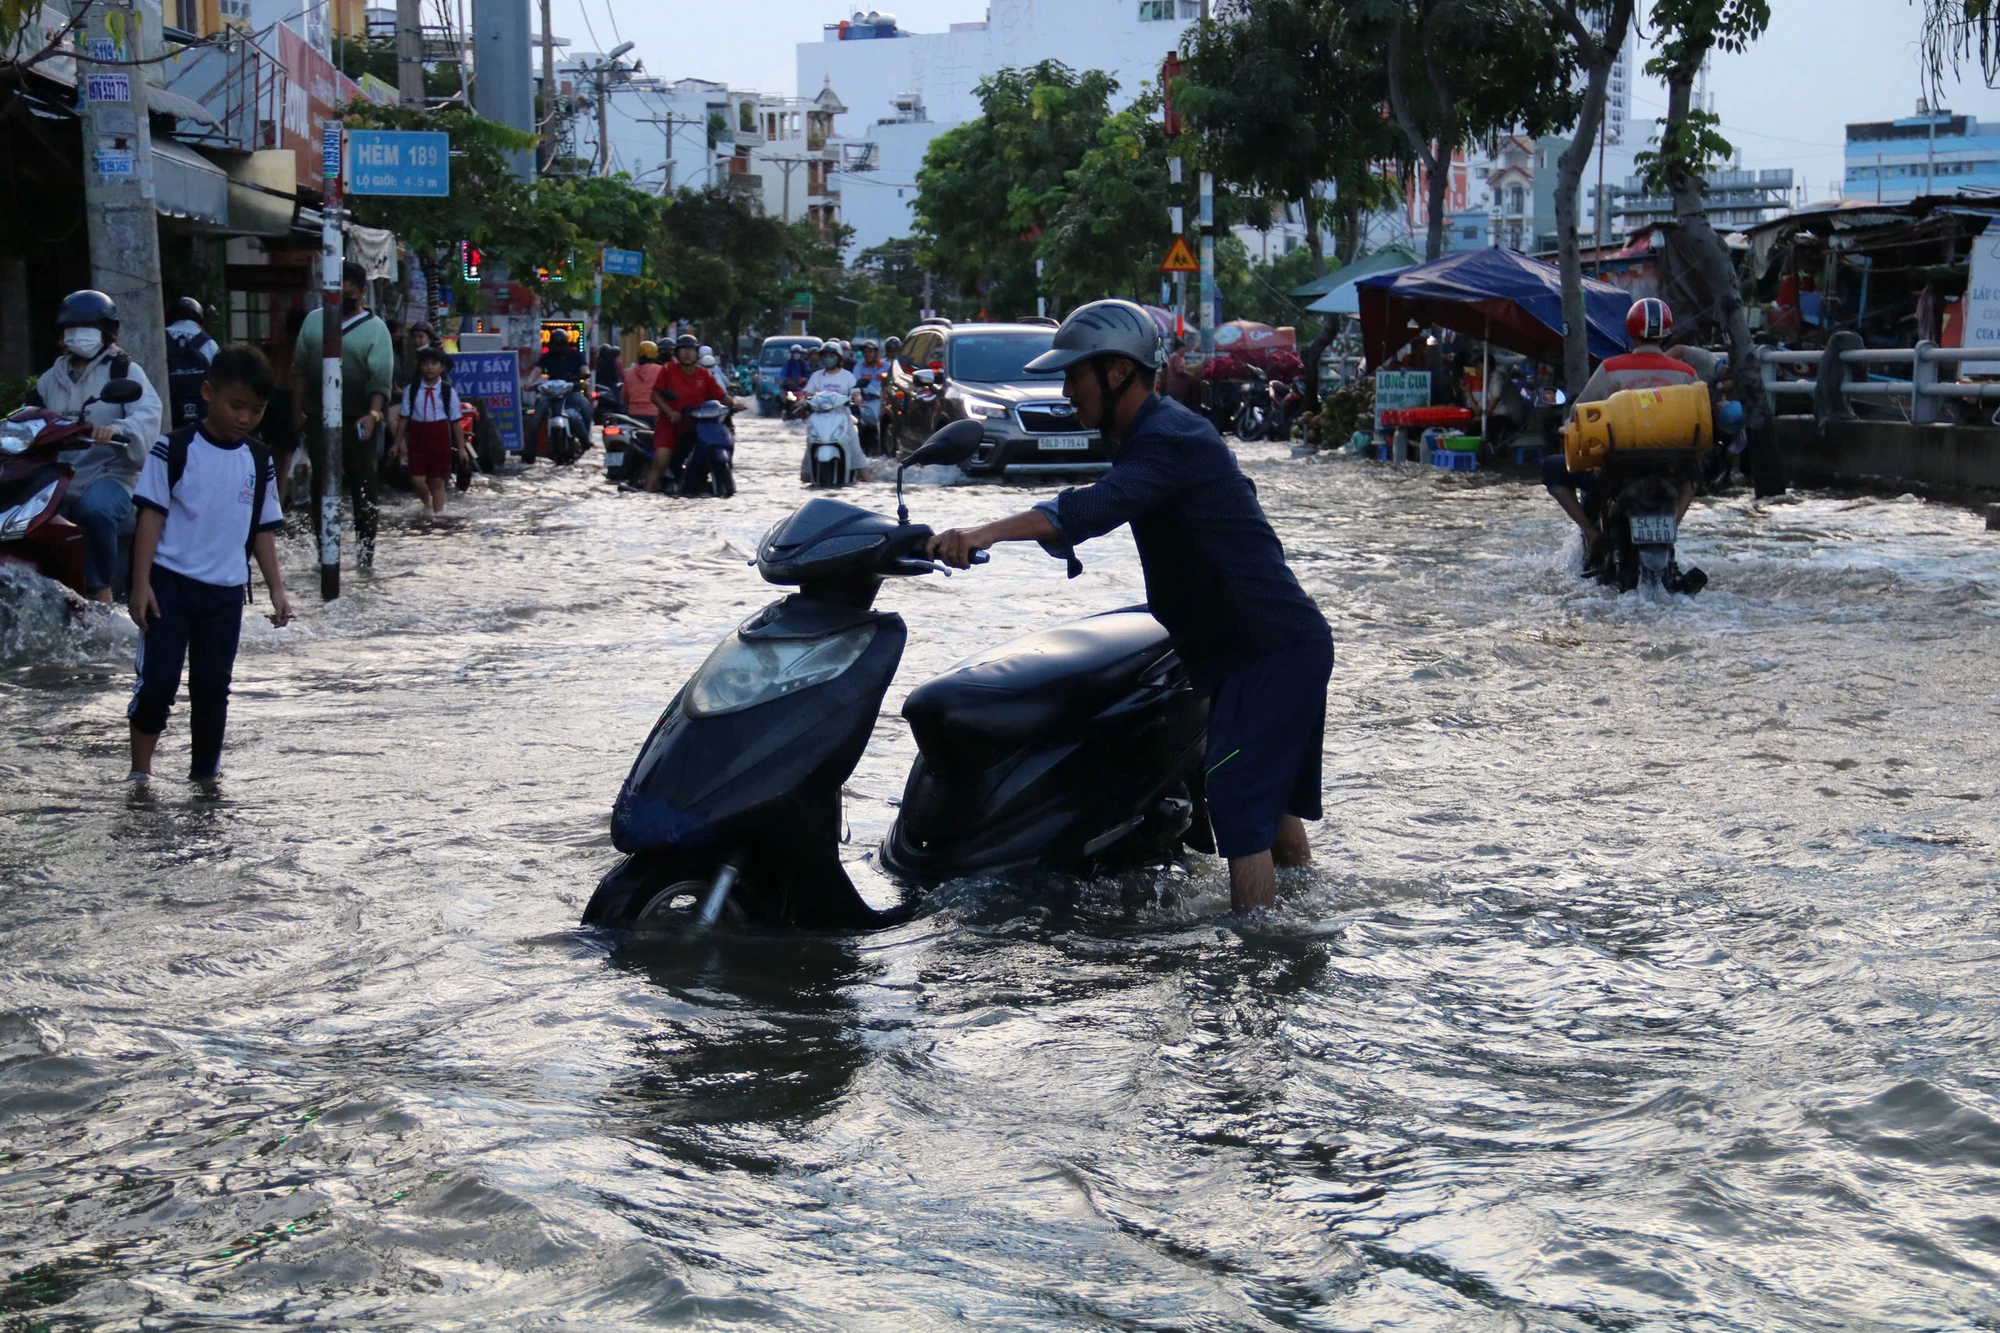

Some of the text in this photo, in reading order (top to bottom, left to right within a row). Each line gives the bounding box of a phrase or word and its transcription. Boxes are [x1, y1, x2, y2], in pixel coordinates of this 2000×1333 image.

[358, 137, 438, 166] HẺM 189
[1378, 374, 1427, 389] LONG CUA
[1637, 518, 1669, 529] 54-F4
